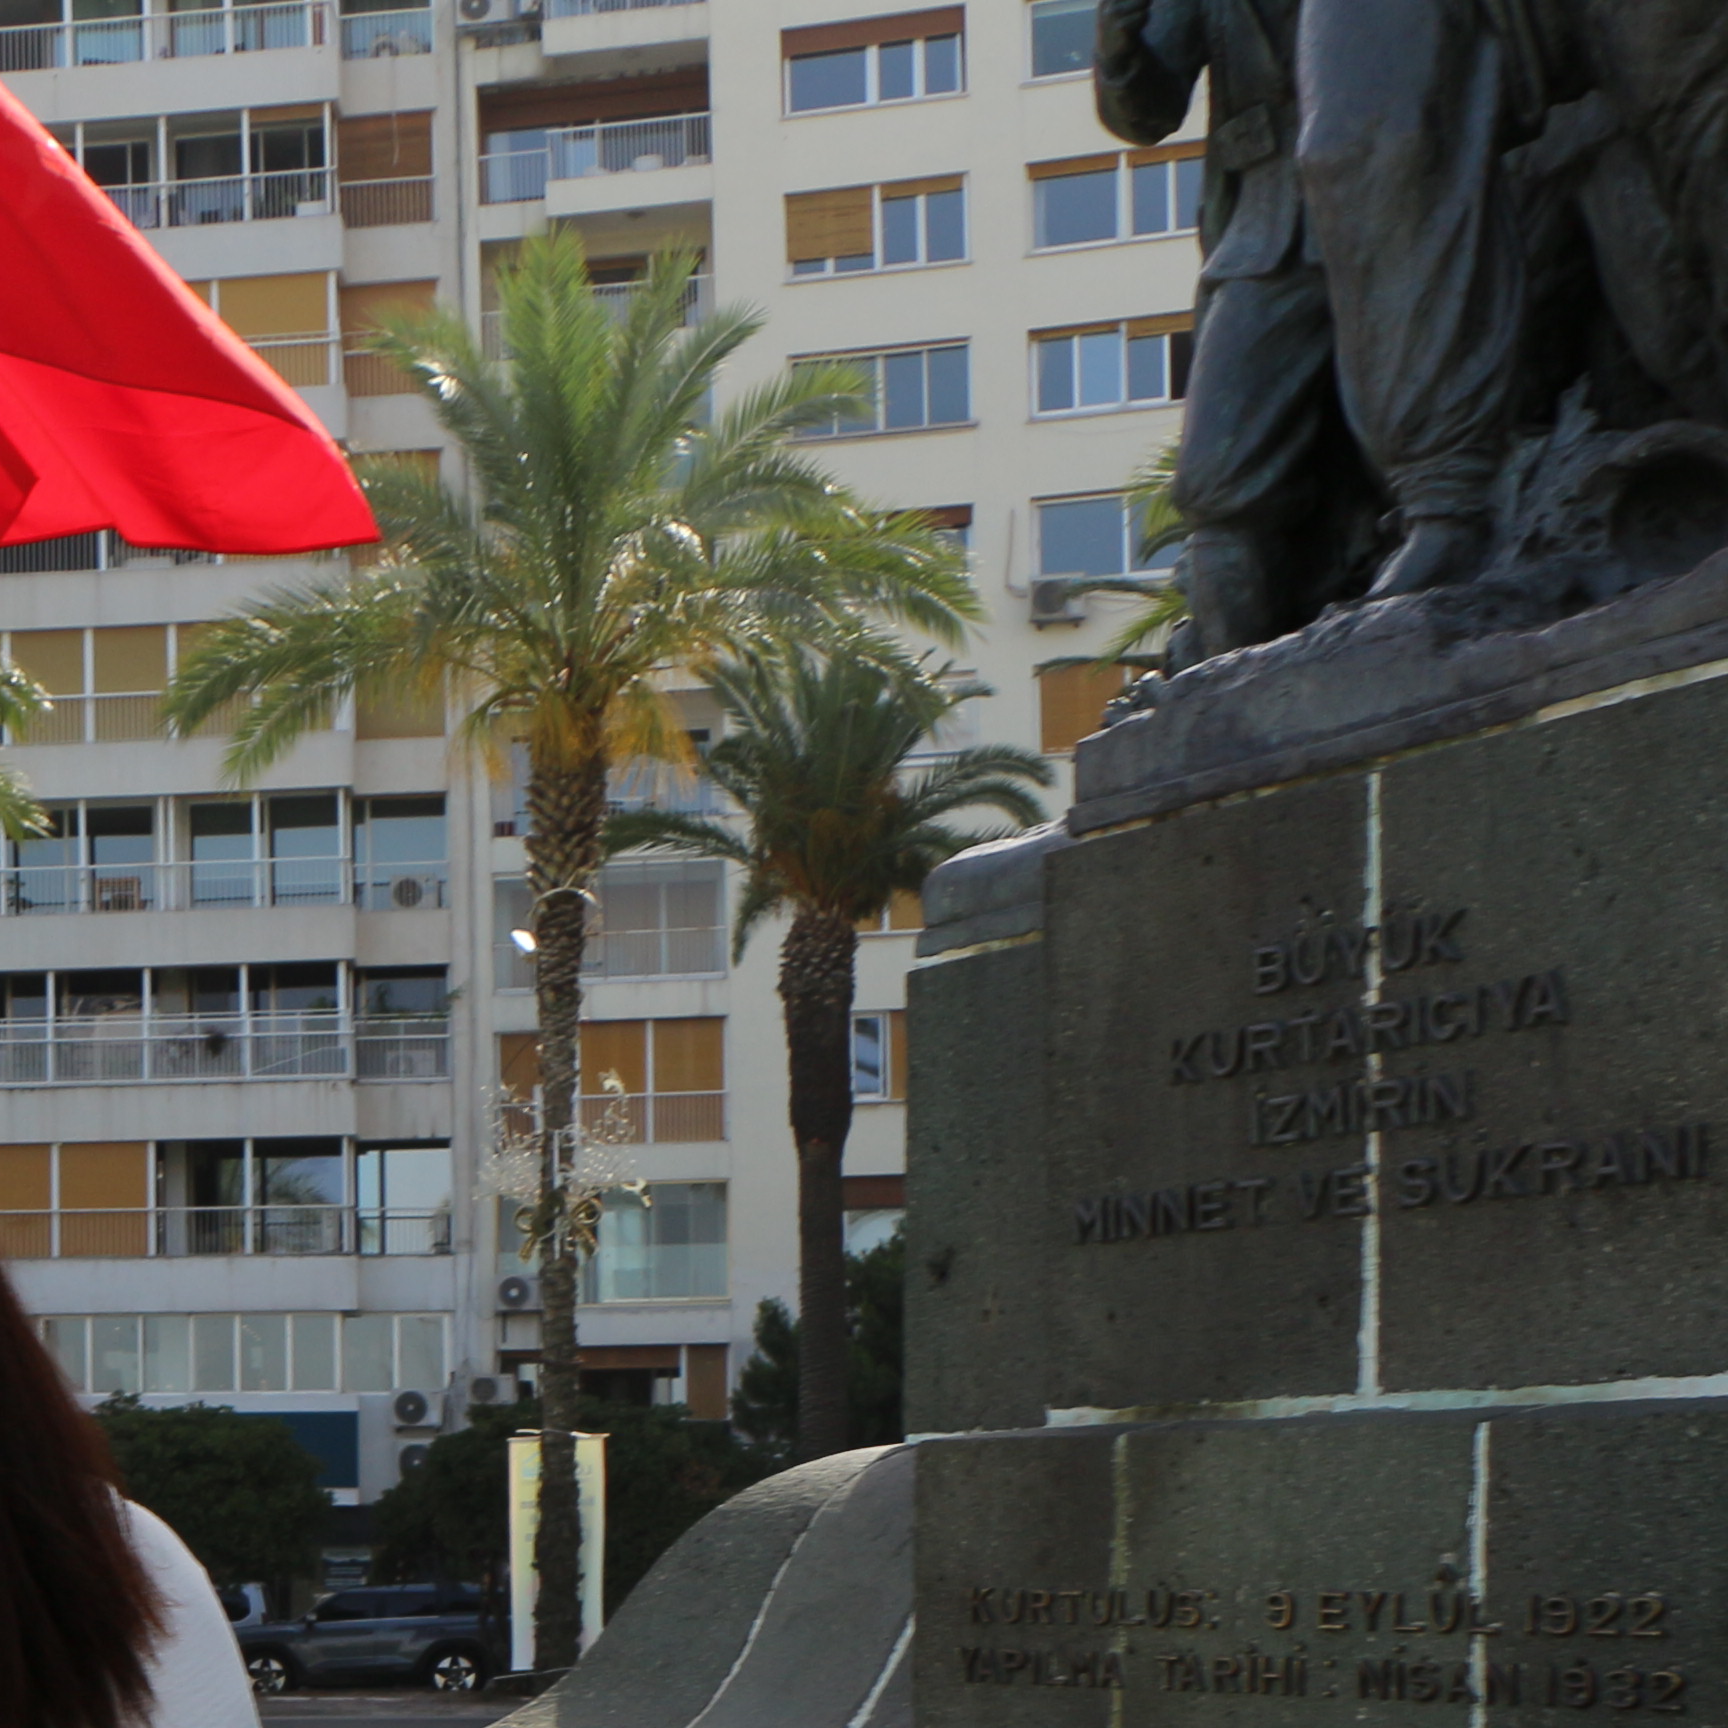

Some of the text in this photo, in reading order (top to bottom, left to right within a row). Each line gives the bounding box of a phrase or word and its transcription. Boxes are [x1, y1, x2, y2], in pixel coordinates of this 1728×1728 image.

[1251, 902, 1469, 996] BÜYÜK
[1299, 1162, 1374, 1222] VE
[1264, 1591, 1296, 1631] 9
[1523, 1591, 1669, 1639] 1922
[1545, 1659, 1690, 1713] 1932
